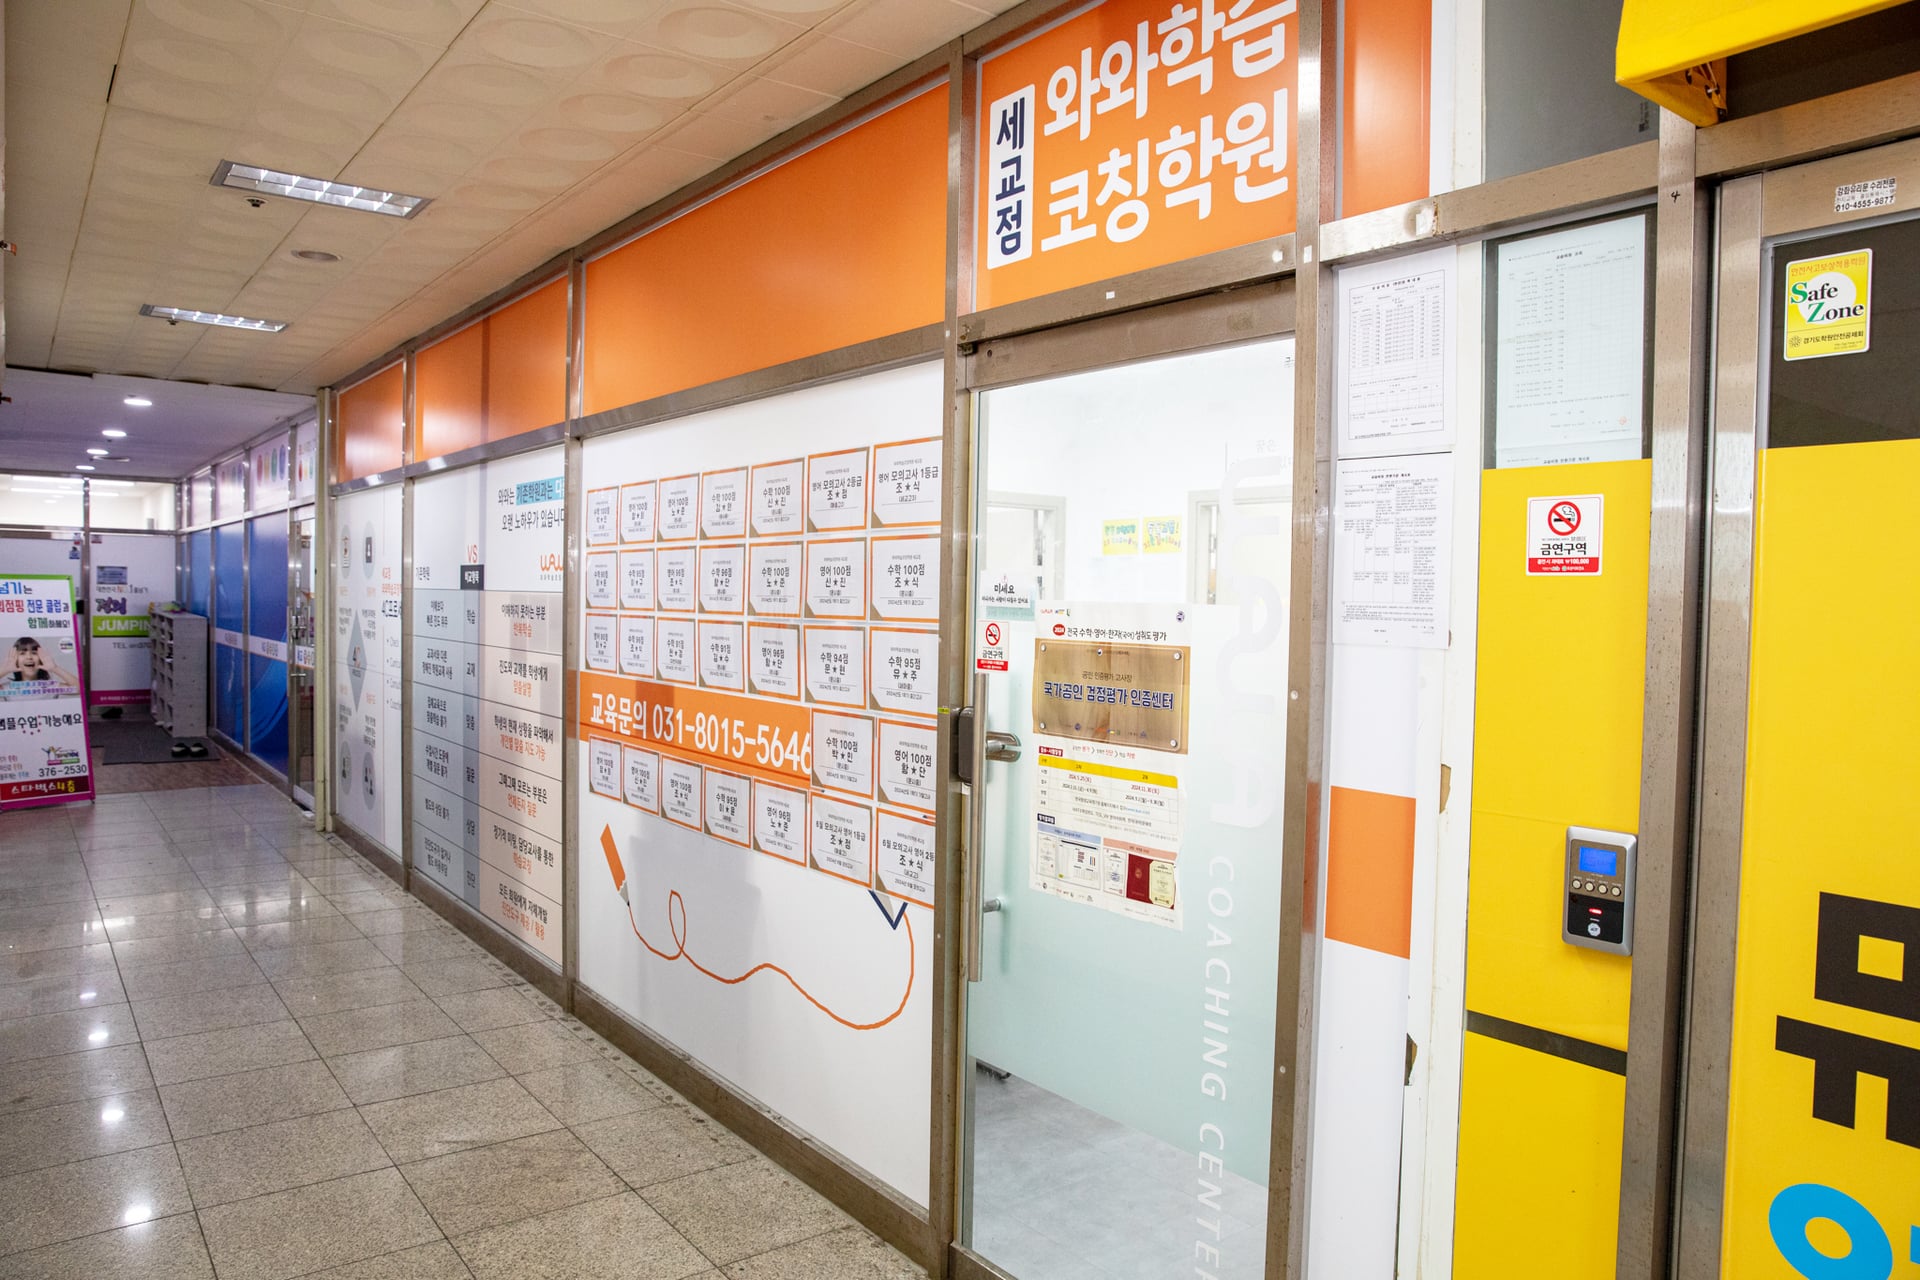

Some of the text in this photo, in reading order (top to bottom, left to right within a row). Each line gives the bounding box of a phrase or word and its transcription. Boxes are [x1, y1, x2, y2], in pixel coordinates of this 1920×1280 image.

[1043, 0, 1298, 141] 와와학습
[995, 96, 1026, 257] 세교점
[1040, 87, 1289, 253] 코칭학원
[1835, 195, 1894, 212] 010-4555-9877
[1790, 282, 1839, 304] Safe
[1807, 302, 1864, 323] Zone
[878, 466, 939, 483] 영어 모의고사 1등급
[823, 479, 846, 490] 모의고사
[846, 476, 862, 488] 2등급
[721, 492, 736, 502] 100점
[763, 485, 791, 498] 수학 100점
[514, 511, 539, 530] 노하우가
[467, 544, 477, 563] VS
[1541, 543, 1587, 556] 금연구역
[762, 566, 790, 578] 수학 100점
[820, 565, 851, 577] 영어 100점
[887, 563, 925, 576] 수학 100점
[993, 581, 1016, 595] 미세요
[535, 606, 546, 620] 부분
[1067, 627, 1078, 637] 전국
[1135, 630, 1152, 640] 성취도
[1153, 631, 1167, 641] 평가
[820, 652, 849, 664] 수학 94점
[982, 649, 1004, 660] 금연구역
[888, 656, 921, 670] 수학 95점
[1044, 681, 1174, 710] 국가공인 검정평가 인증센터
[590, 692, 811, 775] 교육문의 031-8015-5646
[825, 737, 858, 753] 수학 100점
[894, 749, 932, 767] 영어 100점
[38, 764, 87, 777] 376-2530
[11, 781, 57, 794] 스타벅스
[679, 782, 692, 793] 100점
[715, 792, 725, 803] 수학
[766, 806, 791, 822] 영어 96점
[824, 822, 842, 835] 모의고사
[892, 841, 913, 856] 모의고사
[913, 847, 924, 859] 영어
[1201, 855, 1235, 1101] COACHING
